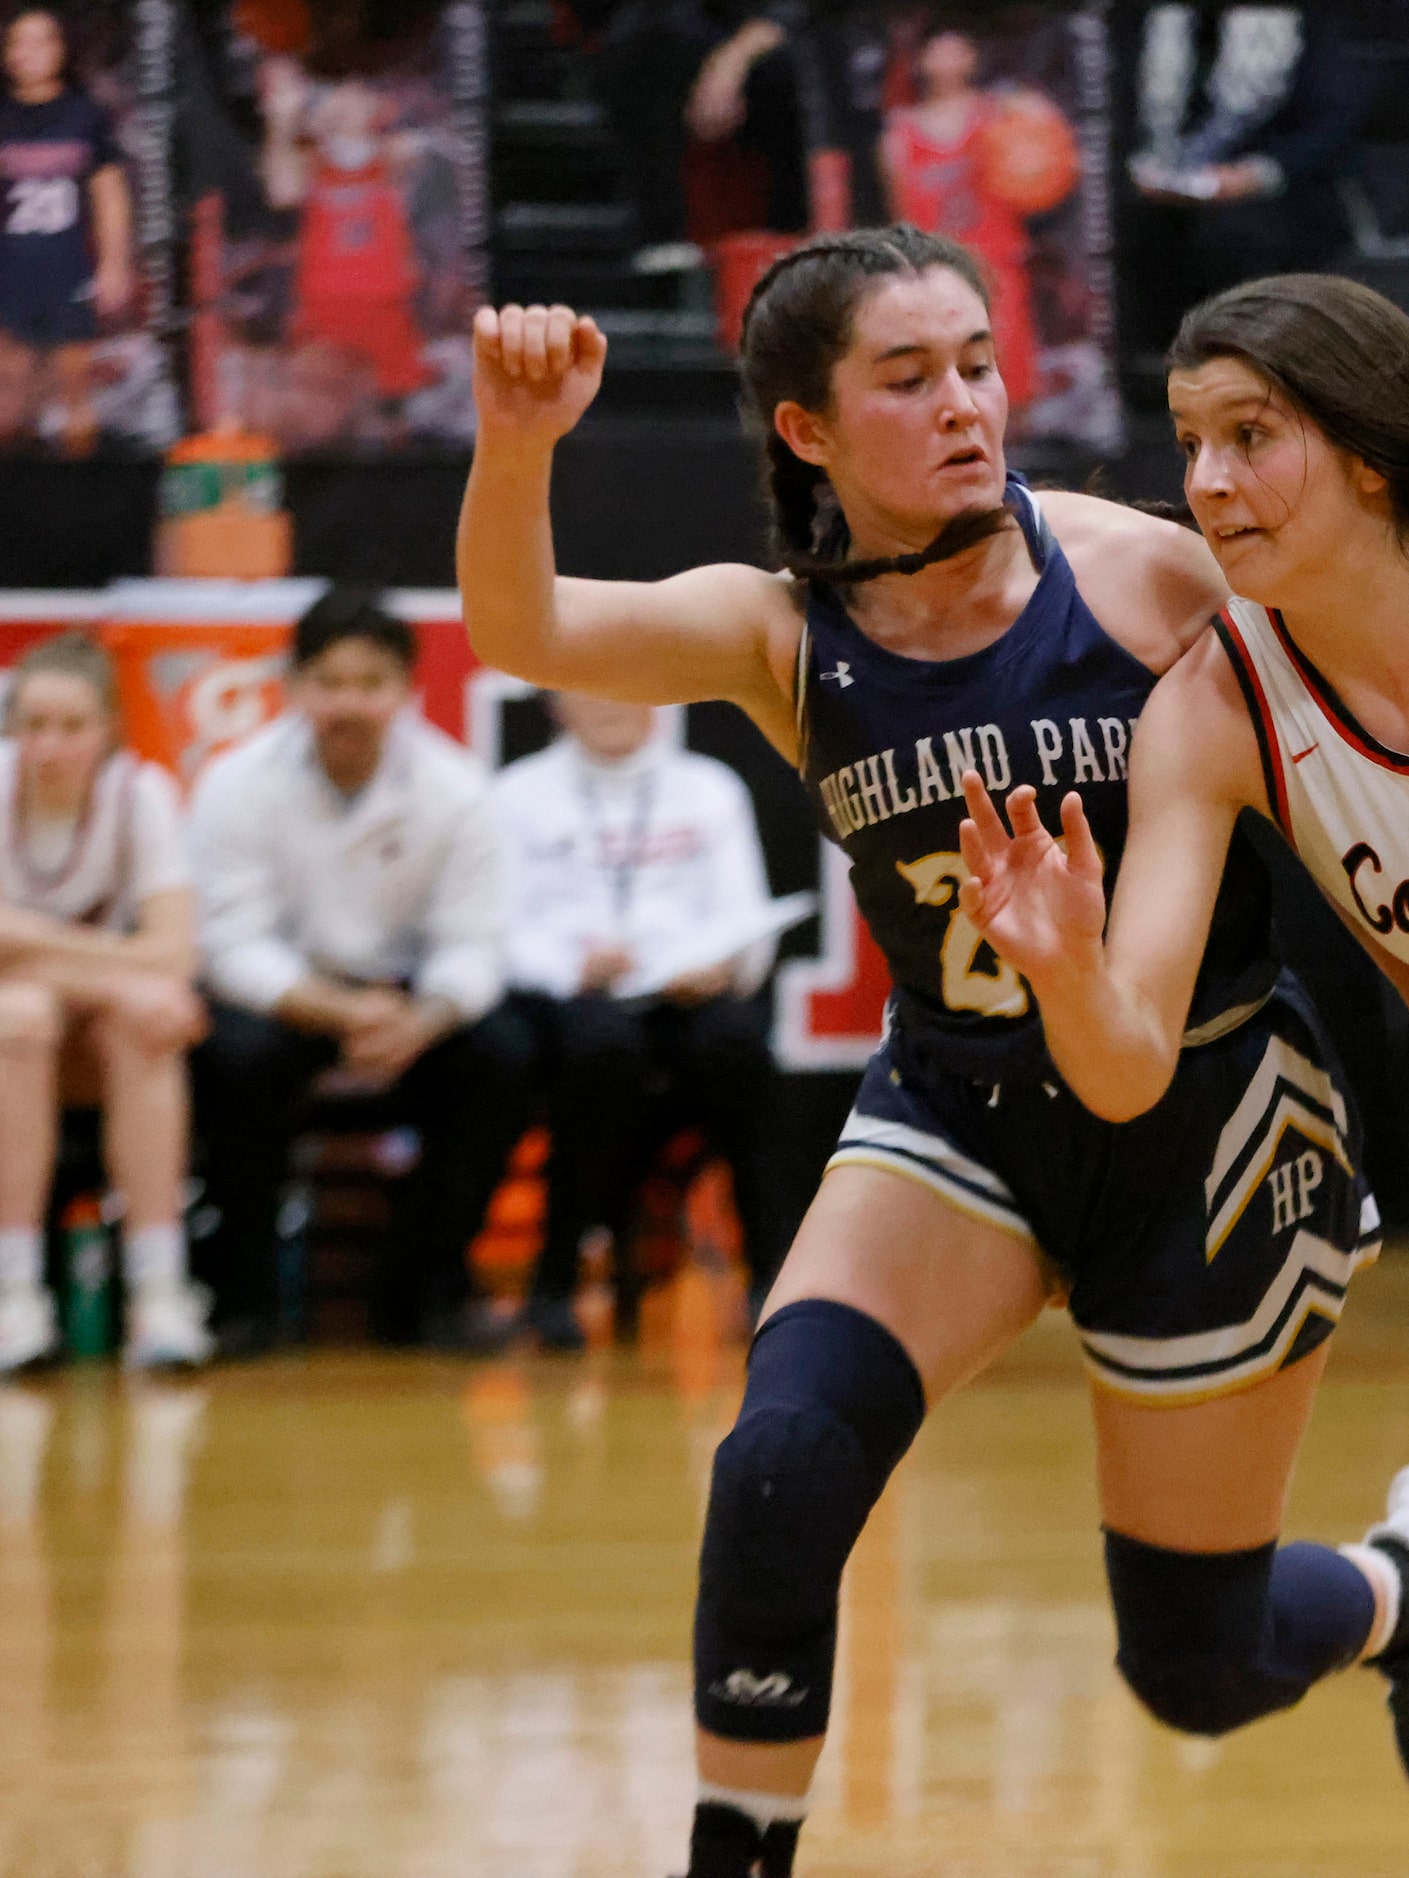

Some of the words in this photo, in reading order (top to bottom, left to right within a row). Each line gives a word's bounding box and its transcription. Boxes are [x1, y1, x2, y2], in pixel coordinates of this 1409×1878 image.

[819, 723, 1013, 840] HIGHLAND
[1030, 717, 1139, 786] PAR
[1266, 1149, 1324, 1237] HP
